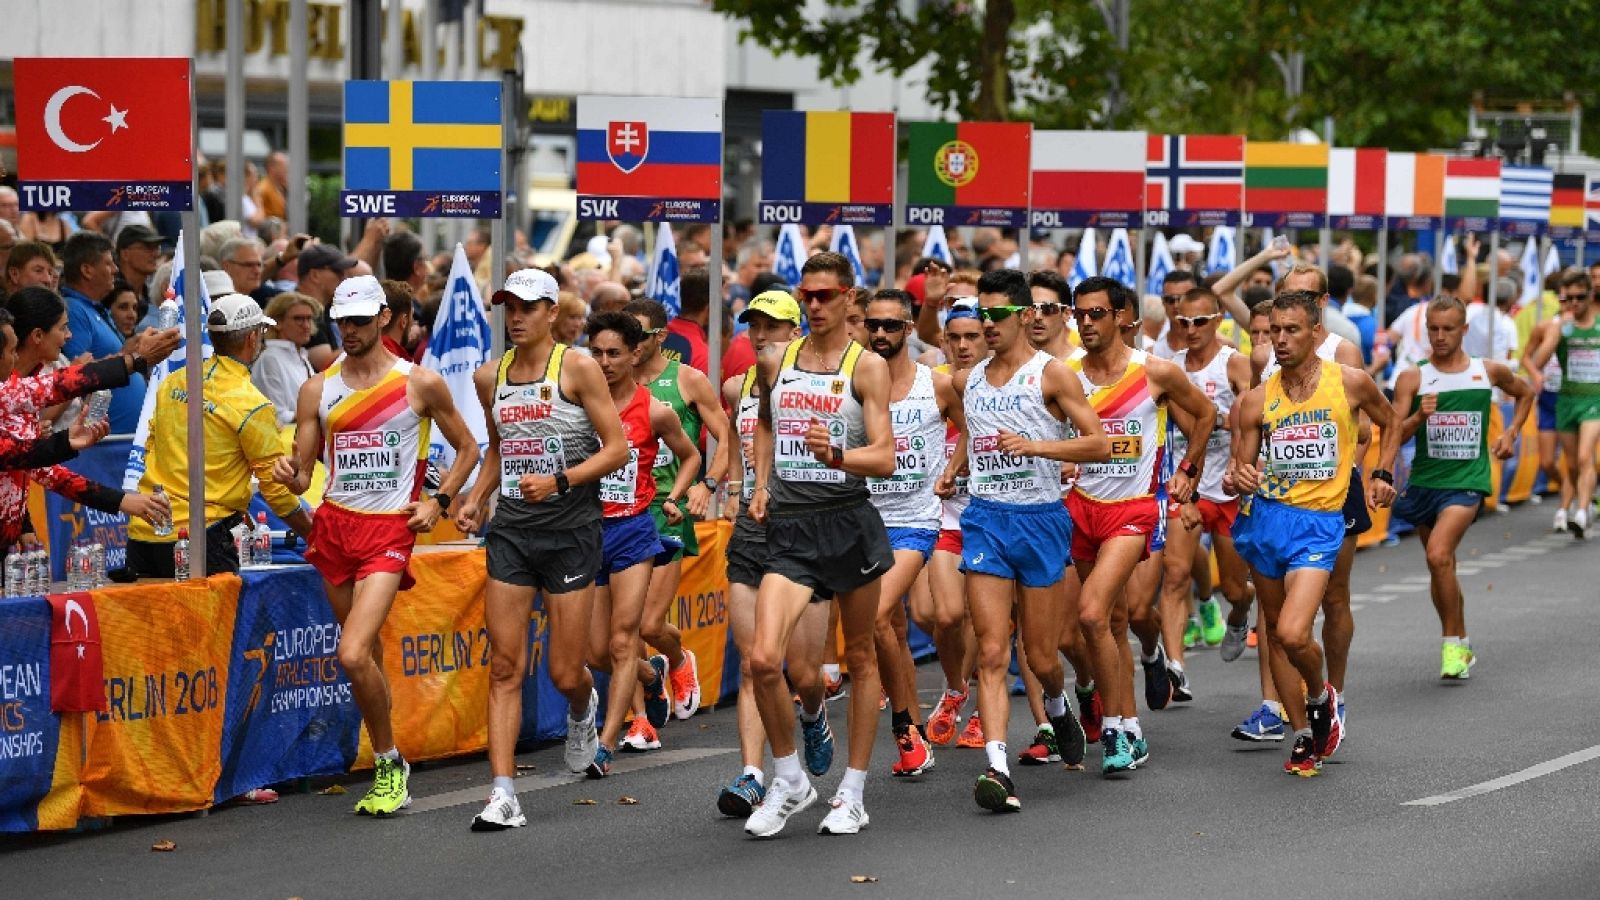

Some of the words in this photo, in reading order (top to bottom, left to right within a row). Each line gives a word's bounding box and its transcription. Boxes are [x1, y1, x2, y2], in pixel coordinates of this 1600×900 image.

[22, 185, 71, 208] TUR
[126, 185, 170, 195] EUROPEAN
[344, 195, 396, 214] SWE
[580, 199, 620, 218] SVK
[763, 205, 802, 222] ROU
[909, 207, 945, 225] POR
[1032, 211, 1063, 228] POL
[779, 390, 845, 414] GERMANY
[499, 403, 552, 424] GERMANY
[1276, 408, 1333, 429] UKRAINE
[1429, 414, 1468, 426] SPAR
[336, 433, 383, 449] SPAR
[1272, 425, 1319, 440] SPAR
[502, 439, 544, 455] SPAR
[1274, 443, 1326, 461] LOSEV
[337, 451, 390, 470] MARTIN
[976, 453, 1024, 473] STANO
[376, 479, 398, 490] 2018
[781, 470, 812, 481] BERLIN
[815, 471, 839, 481] 2018
[401, 630, 474, 677] BERLIN
[0, 661, 42, 700] EAN
[274, 655, 340, 689] ATHLETICS
[271, 682, 353, 714] CHAMPIONSHIPS
